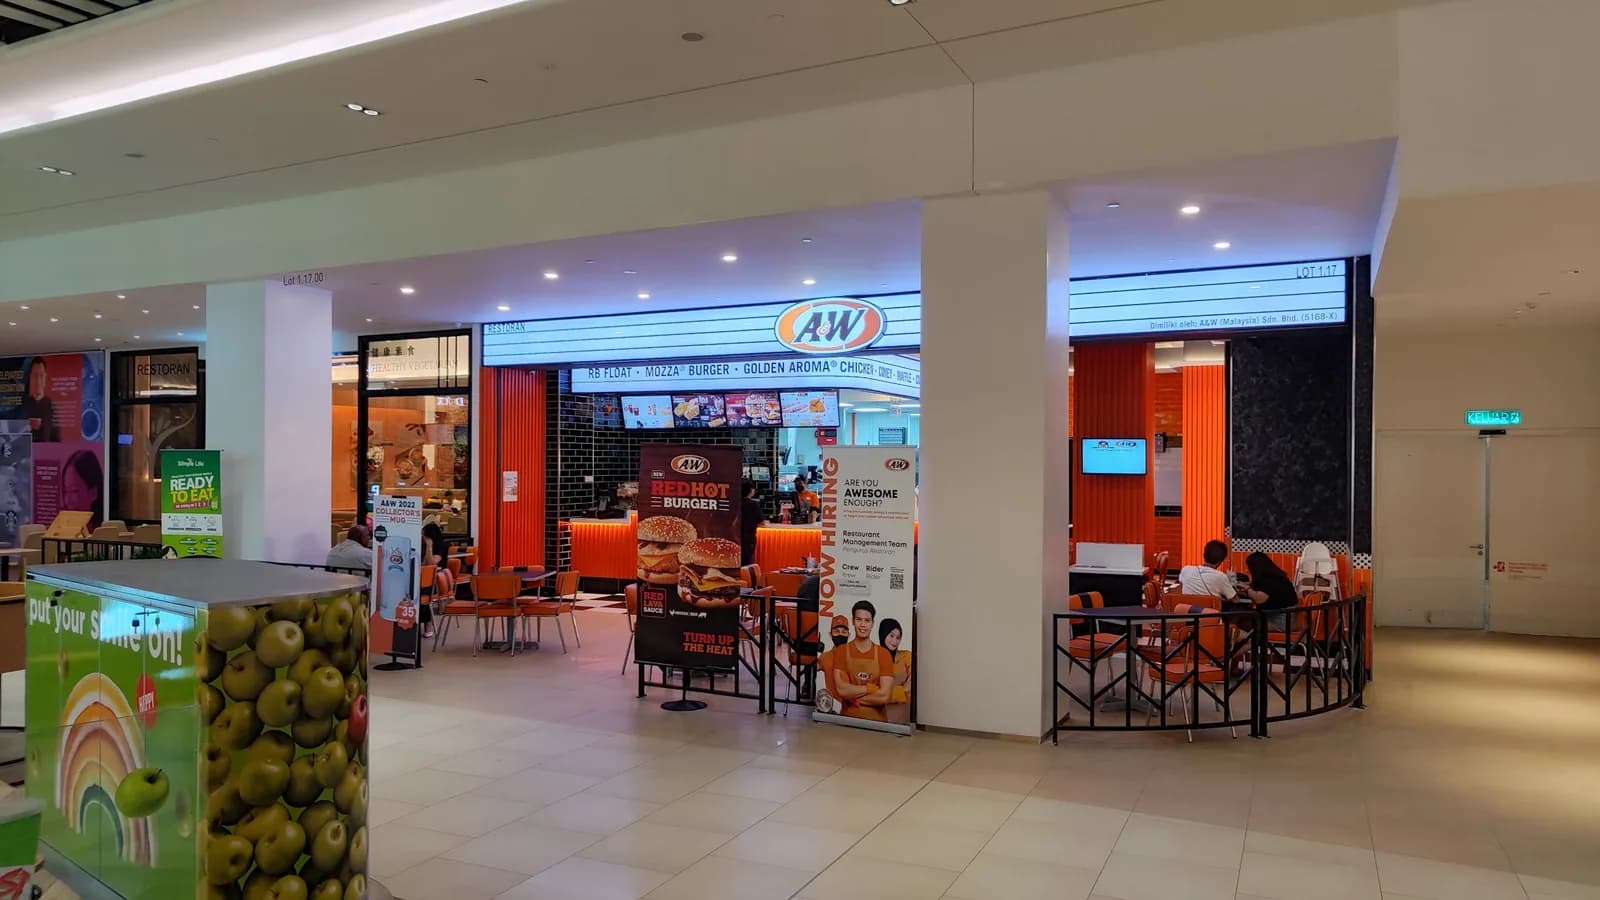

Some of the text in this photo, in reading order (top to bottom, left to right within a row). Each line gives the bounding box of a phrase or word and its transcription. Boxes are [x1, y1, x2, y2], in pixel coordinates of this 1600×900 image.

[1296, 264, 1337, 279] LOT 1.17
[283, 272, 324, 286] Lot 1.17.00
[792, 306, 868, 344] A&W
[1200, 318, 1217, 327] A&W
[1220, 316, 1259, 327] (Malaysia)
[1301, 312, 1338, 322] (5168-X)
[487, 321, 526, 334] RESTORAN
[137, 363, 190, 376] RESTORAN
[588, 368, 600, 379] RB
[604, 367, 632, 378] FLOAT
[689, 364, 730, 375] BURGER
[744, 362, 785, 374] GOLDEN
[840, 360, 874, 375] CHICKEN
[1468, 412, 1508, 423] KELUAR
[170, 475, 214, 491] READY
[844, 479, 879, 487] ARE YOU
[171, 487, 214, 503] TO EAT
[844, 488, 898, 498] AWESOME
[381, 499, 416, 508] A&W 2022
[663, 497, 718, 510] BURGER
[822, 457, 839, 546] HIRING
[843, 499, 883, 507] ENOUGH?
[376, 508, 420, 516] COLLECTOR'S
[390, 516, 406, 524] MUG
[842, 530, 880, 538] Restaurant
[842, 539, 887, 547] Management
[842, 563, 859, 571] Crew
[819, 552, 836, 618] NOW
[643, 592, 664, 600] RED
[402, 606, 414, 617] 35
[29, 598, 50, 625] put
[54, 604, 85, 634] your
[148, 621, 183, 666] on!
[683, 632, 734, 645] TURN UP
[683, 643, 734, 655] THE HEAT
